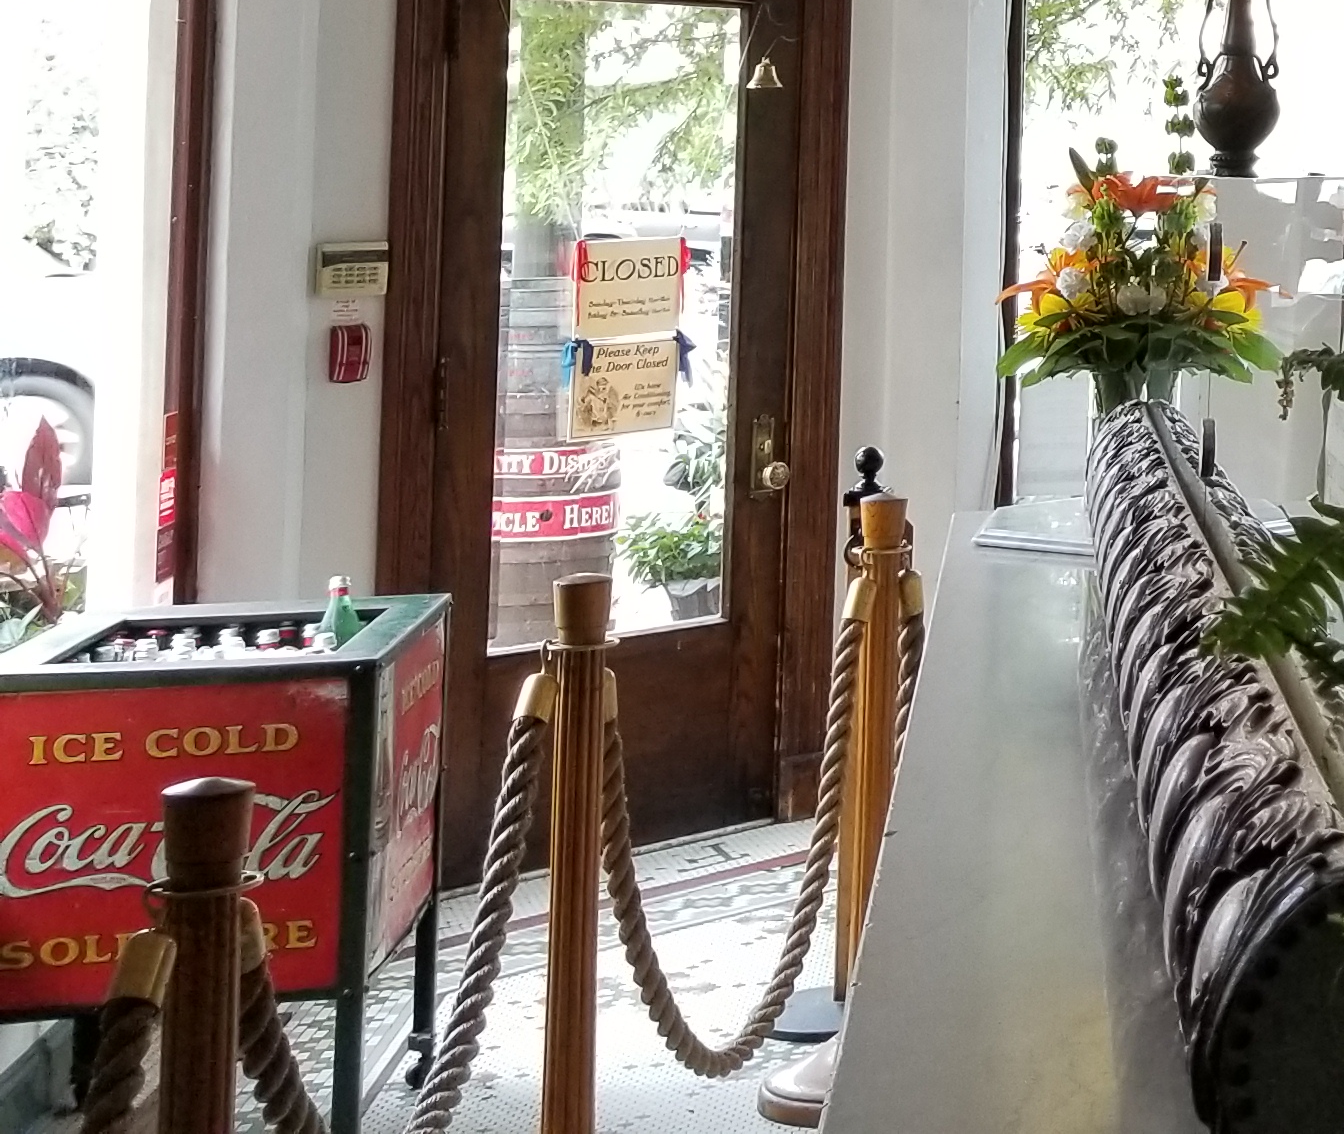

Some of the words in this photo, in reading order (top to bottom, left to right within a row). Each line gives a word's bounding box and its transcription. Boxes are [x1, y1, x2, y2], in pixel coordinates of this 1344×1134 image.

[580, 255, 680, 283] CLOSED
[596, 347, 631, 359] Please
[634, 345, 660, 357] Keep
[606, 361, 633, 373] Door
[636, 357, 669, 370] Closed
[563, 501, 614, 529] HERE!
[29, 732, 124, 765] ICE
[146, 723, 299, 758] COLD
[0, 789, 337, 899] Coca-la
